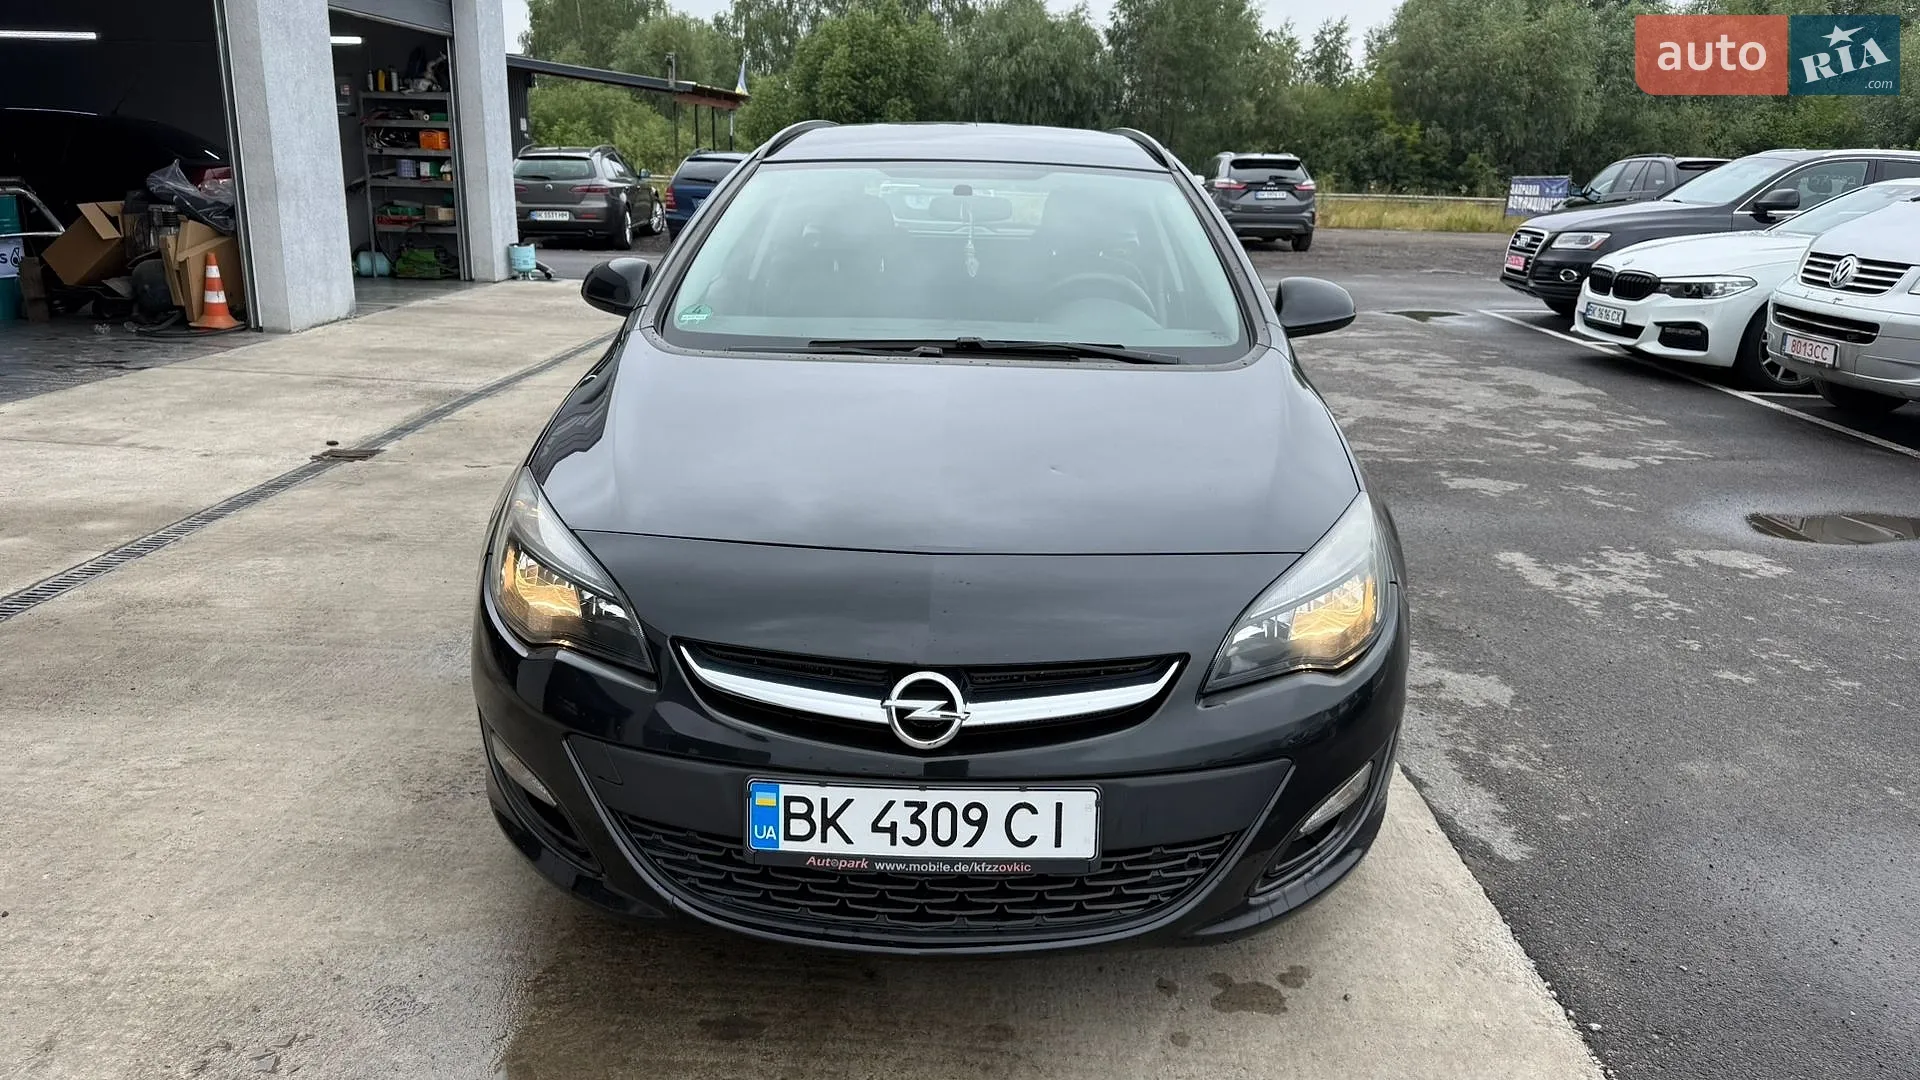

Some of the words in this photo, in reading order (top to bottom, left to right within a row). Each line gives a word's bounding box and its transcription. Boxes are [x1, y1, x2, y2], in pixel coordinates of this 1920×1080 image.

[1791, 339, 1829, 361] 8013CC
[754, 824, 777, 840] UA
[783, 795, 855, 845] BK
[871, 800, 988, 848] 4309
[1004, 801, 1063, 849] CI
[806, 855, 869, 871] Autopark
[874, 861, 1032, 873] www.mobile.de/kfzzovkic
